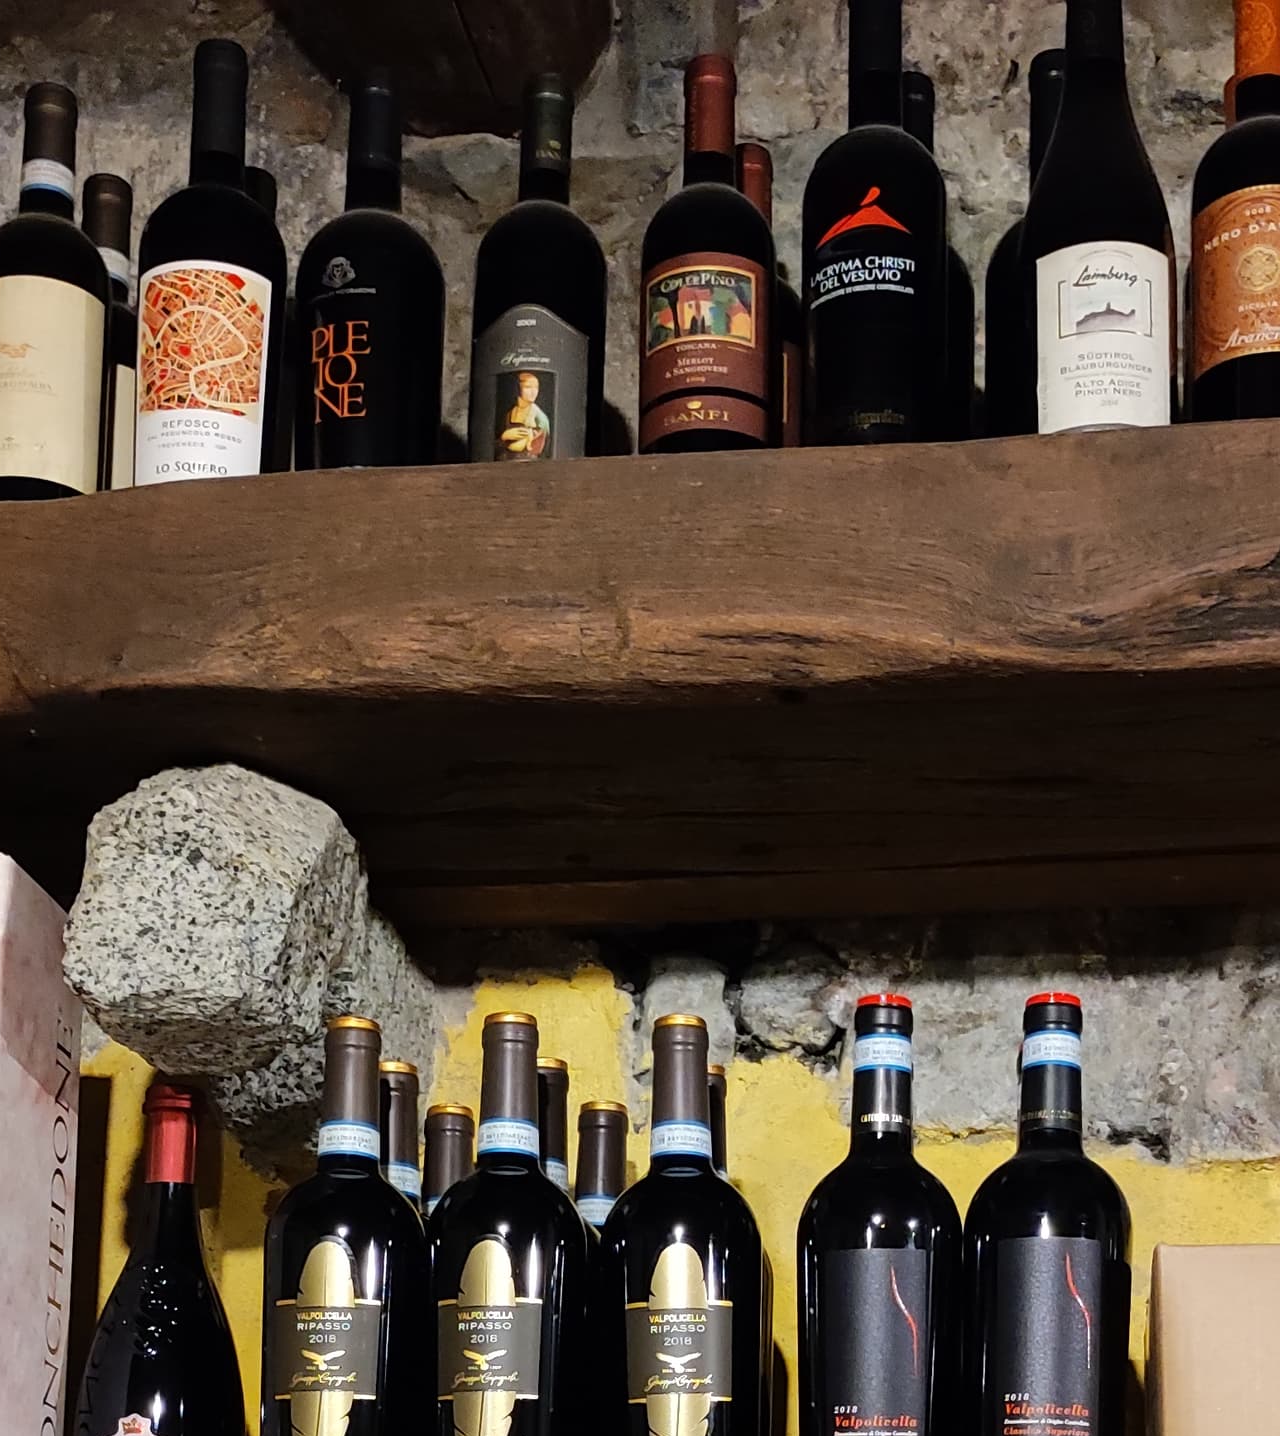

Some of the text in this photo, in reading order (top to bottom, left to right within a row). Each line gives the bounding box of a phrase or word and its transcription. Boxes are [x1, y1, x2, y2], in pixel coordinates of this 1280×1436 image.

[1203, 228, 1241, 252] NERO
[810, 255, 916, 288] LACRYMA CHRISTI
[820, 268, 902, 293] DEL VESUVIO
[677, 356, 714, 367] MERLOT
[1060, 361, 1153, 375] BLAUBURGUNDER
[1073, 378, 1141, 389] ALTO ADIGE
[1074, 387, 1142, 398] PINOT NERO
[162, 420, 221, 431] REFOSCO
[155, 463, 171, 475] LO
[296, 1311, 353, 1321] VALPOLICELLA
[457, 1310, 514, 1320] VALPOLICELLA
[649, 1313, 707, 1324] VALPOLICELLA
[296, 1321, 351, 1331] RIPASSO
[458, 1321, 512, 1331] RIPASSO
[650, 1324, 706, 1334] RIPASSO
[308, 1333, 337, 1344] 2018
[469, 1333, 498, 1344] 2018
[663, 1336, 693, 1346] 2018
[1004, 1392, 1030, 1402] 2018
[833, 1405, 858, 1414] 2018
[1004, 1403, 1090, 1418] Valpolicella
[834, 1415, 918, 1430] Valpolicella
